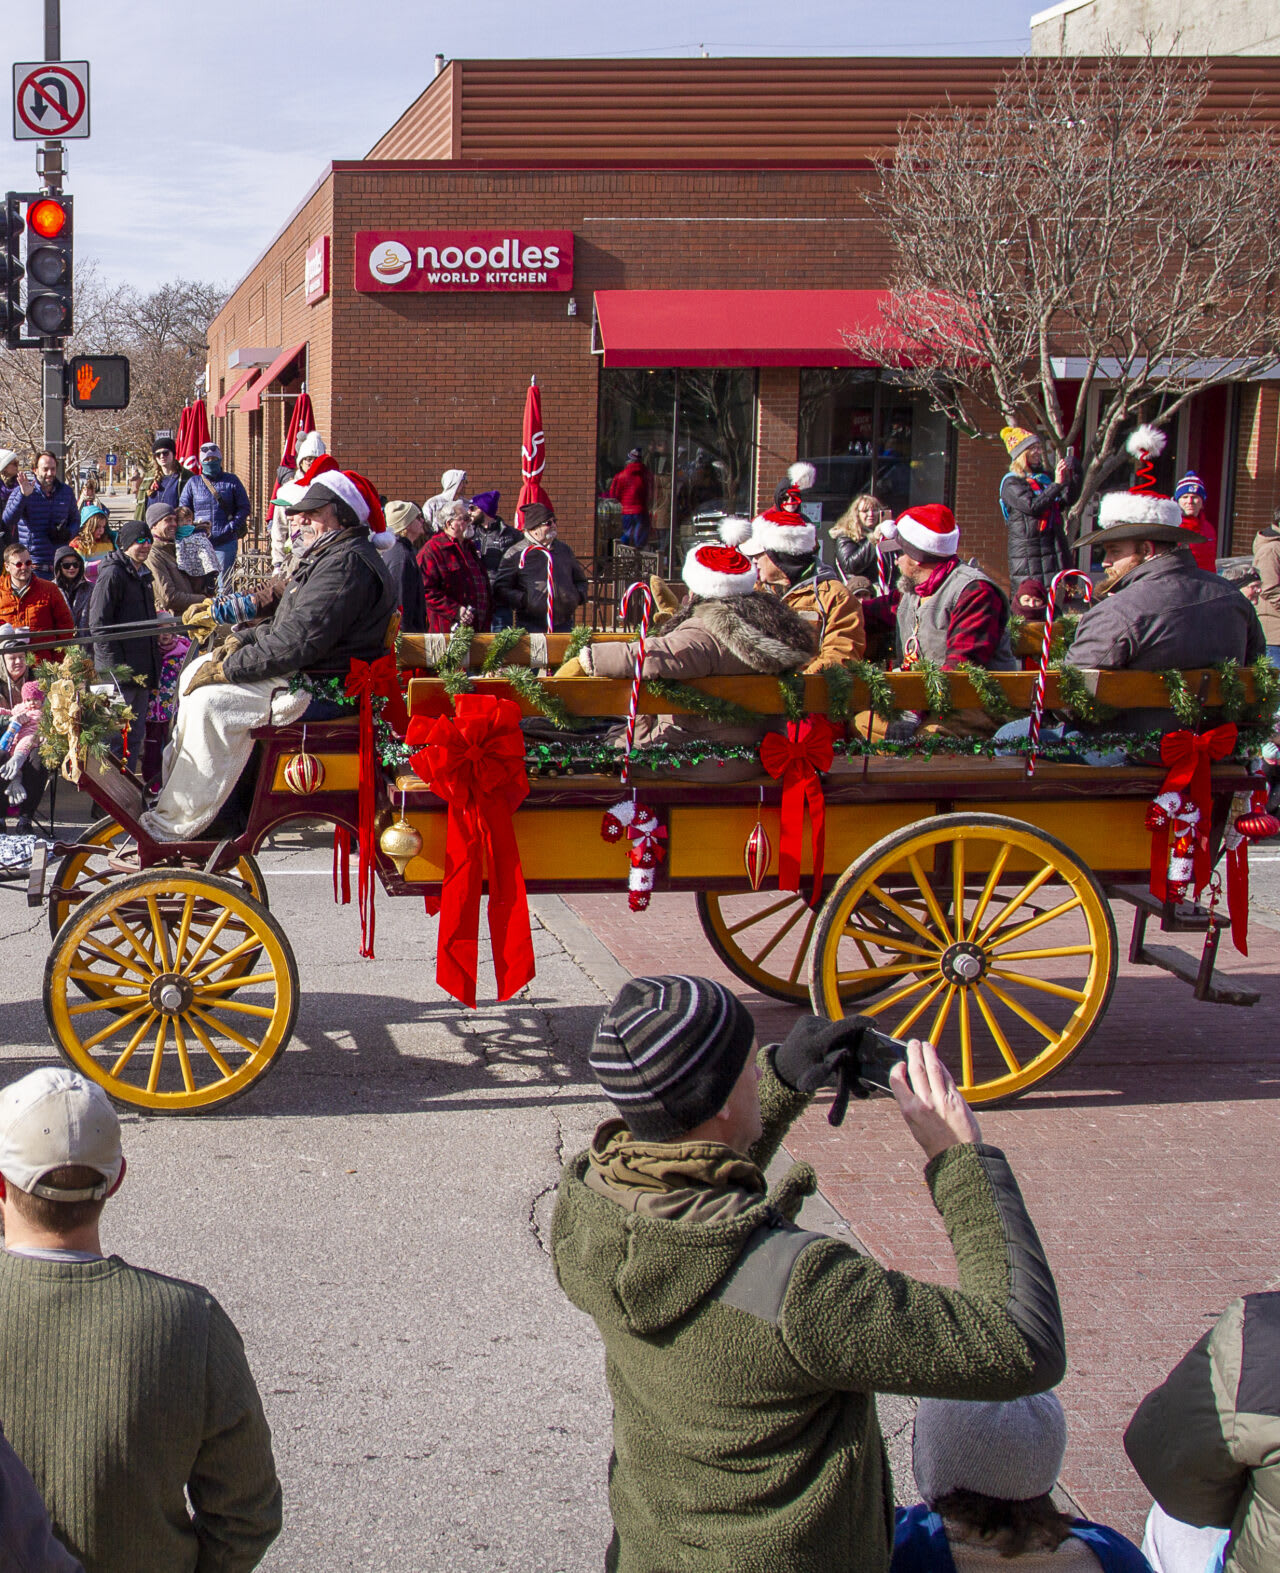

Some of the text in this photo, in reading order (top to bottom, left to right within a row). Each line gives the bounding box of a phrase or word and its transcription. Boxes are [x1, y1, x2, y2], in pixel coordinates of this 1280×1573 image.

[417, 239, 560, 269] noodles
[427, 272, 547, 283] WORLD KITCHEN
